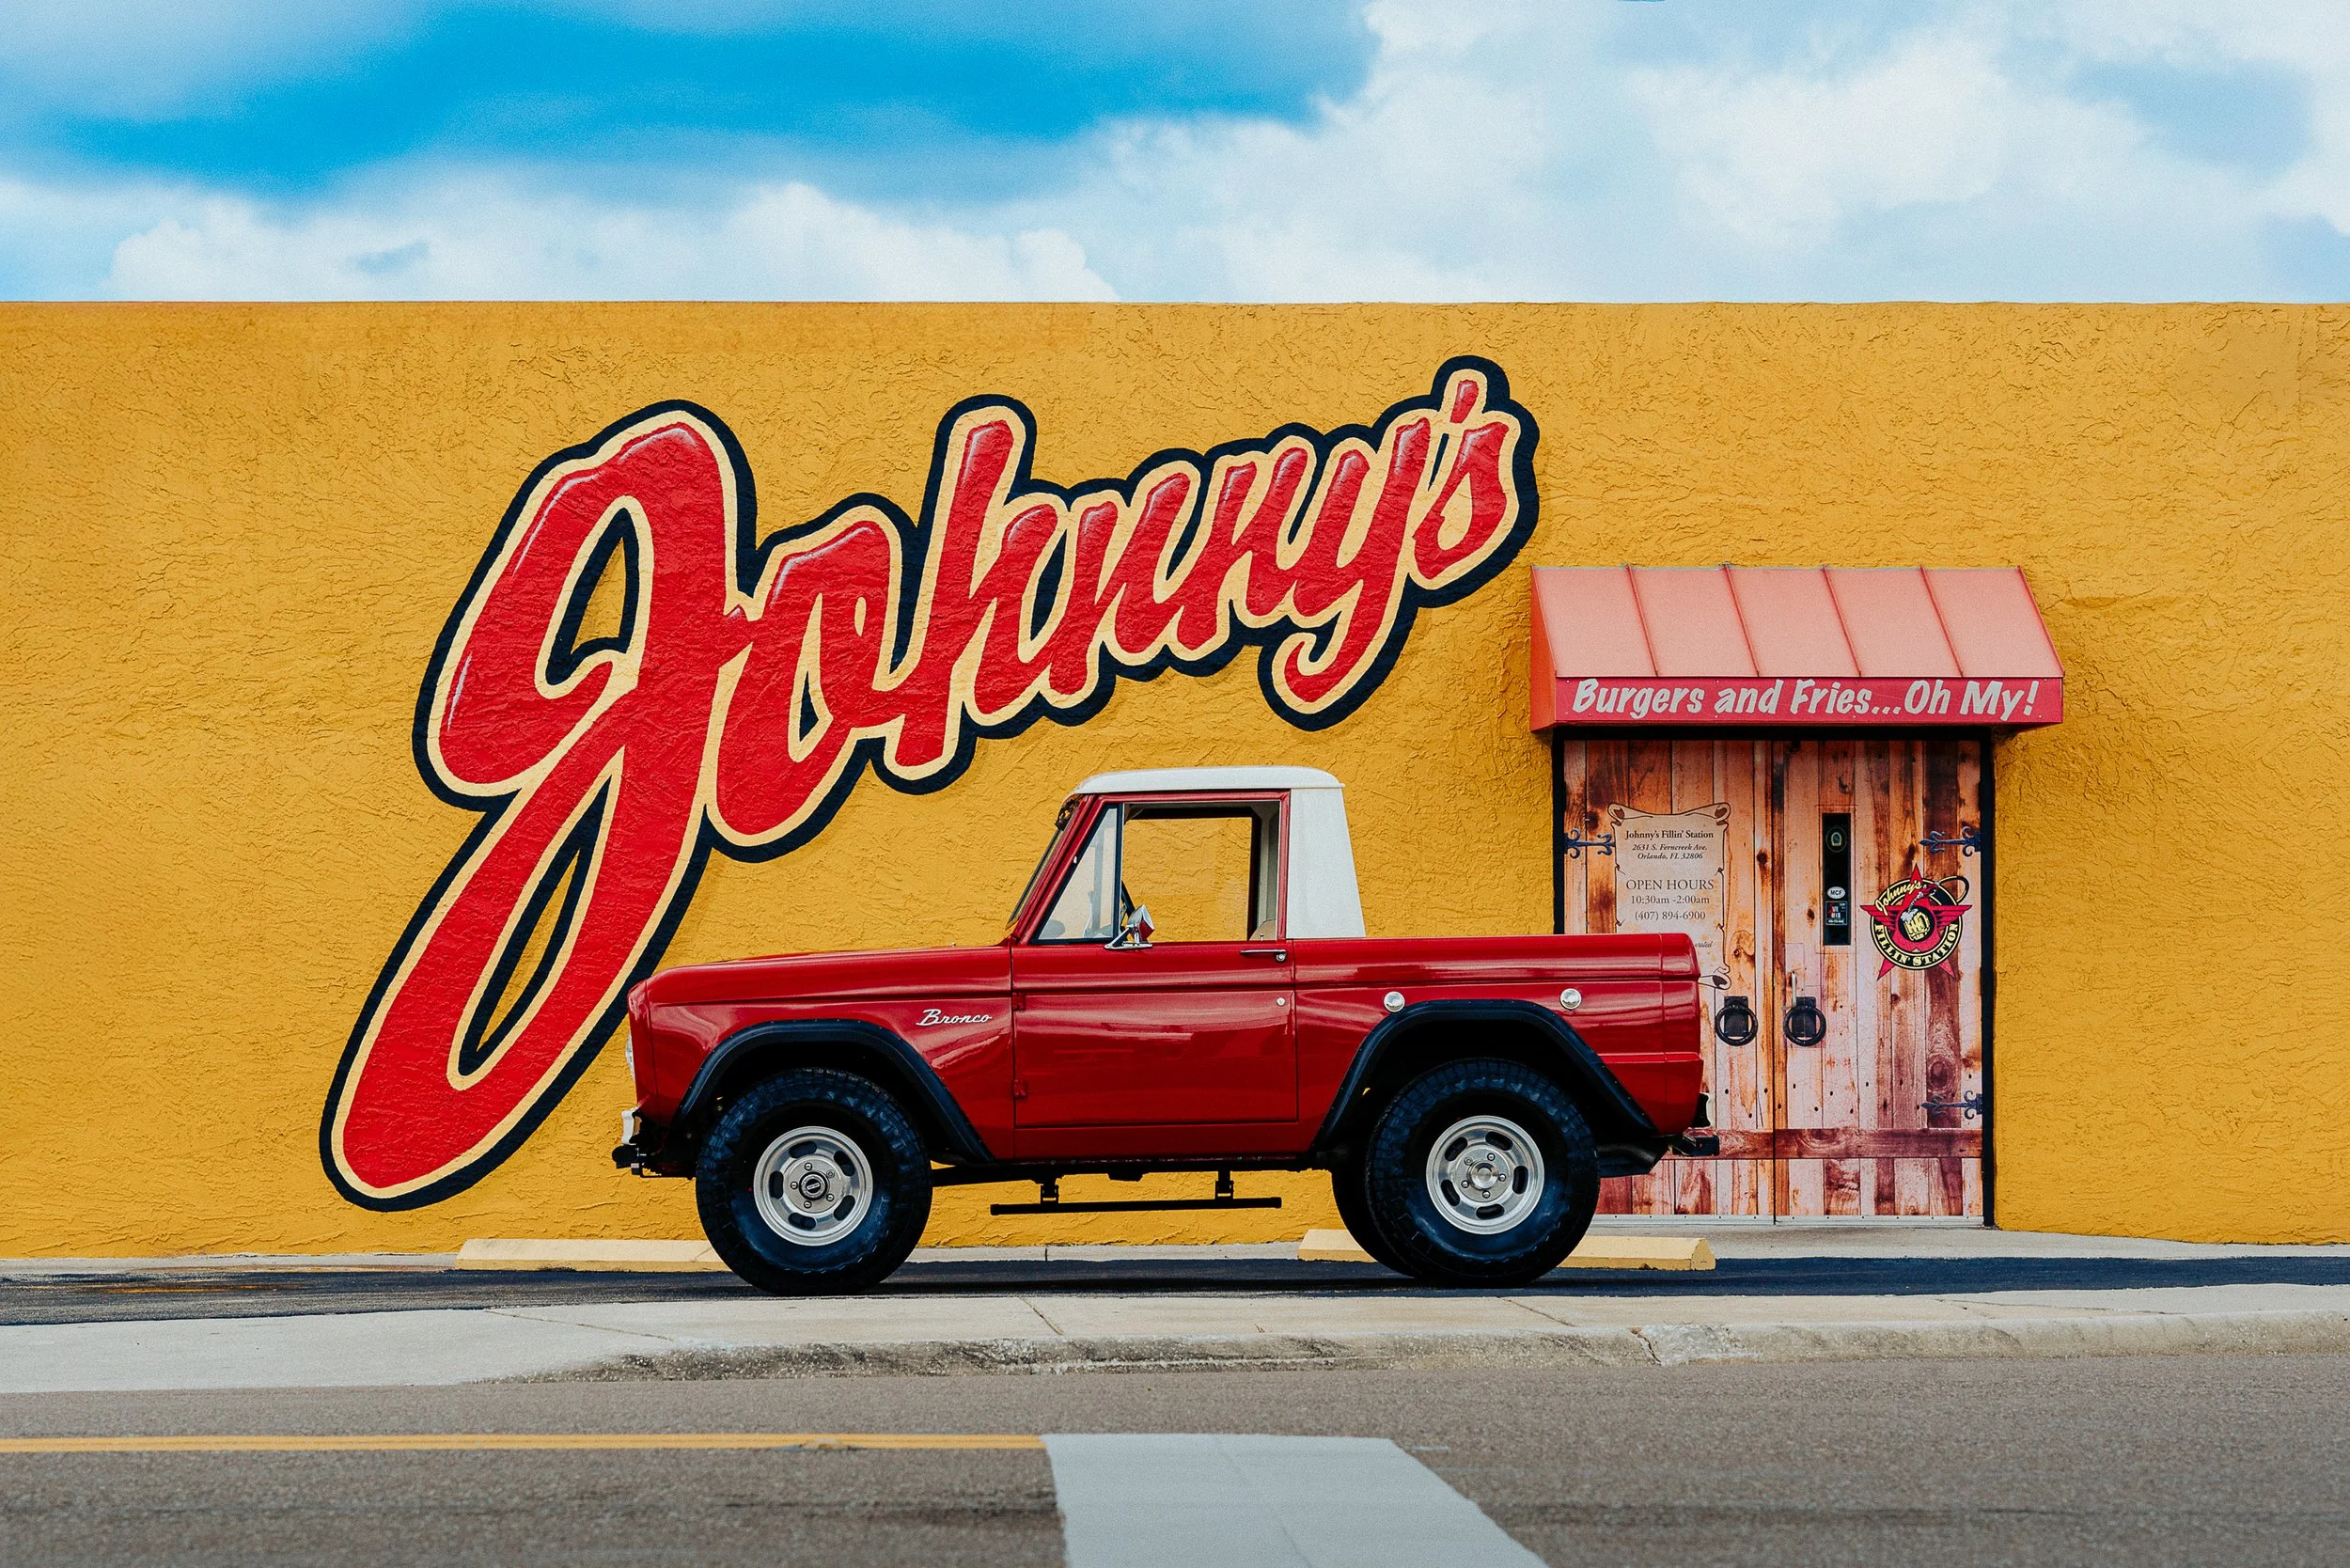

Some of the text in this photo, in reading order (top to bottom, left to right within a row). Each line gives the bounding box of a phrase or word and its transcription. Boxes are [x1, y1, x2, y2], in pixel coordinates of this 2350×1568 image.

[1572, 678, 1705, 719] Burgers
[1714, 679, 1784, 714] and
[1959, 680, 2040, 722] My!
[323, 356, 1540, 1209] Johnny's
[1624, 829, 1715, 840] Johnny's Fillin' Station
[1637, 852, 1668, 860] Orlando,
[1625, 879, 1715, 890] OPEN HOURS
[1631, 895, 1669, 904] 10:30am
[1874, 879, 1922, 916] Johnny's
[1635, 911, 1706, 921] (407) 894-6900
[1874, 923, 1959, 966] FILLIN' STATION
[916, 1008, 993, 1027] Bronco
